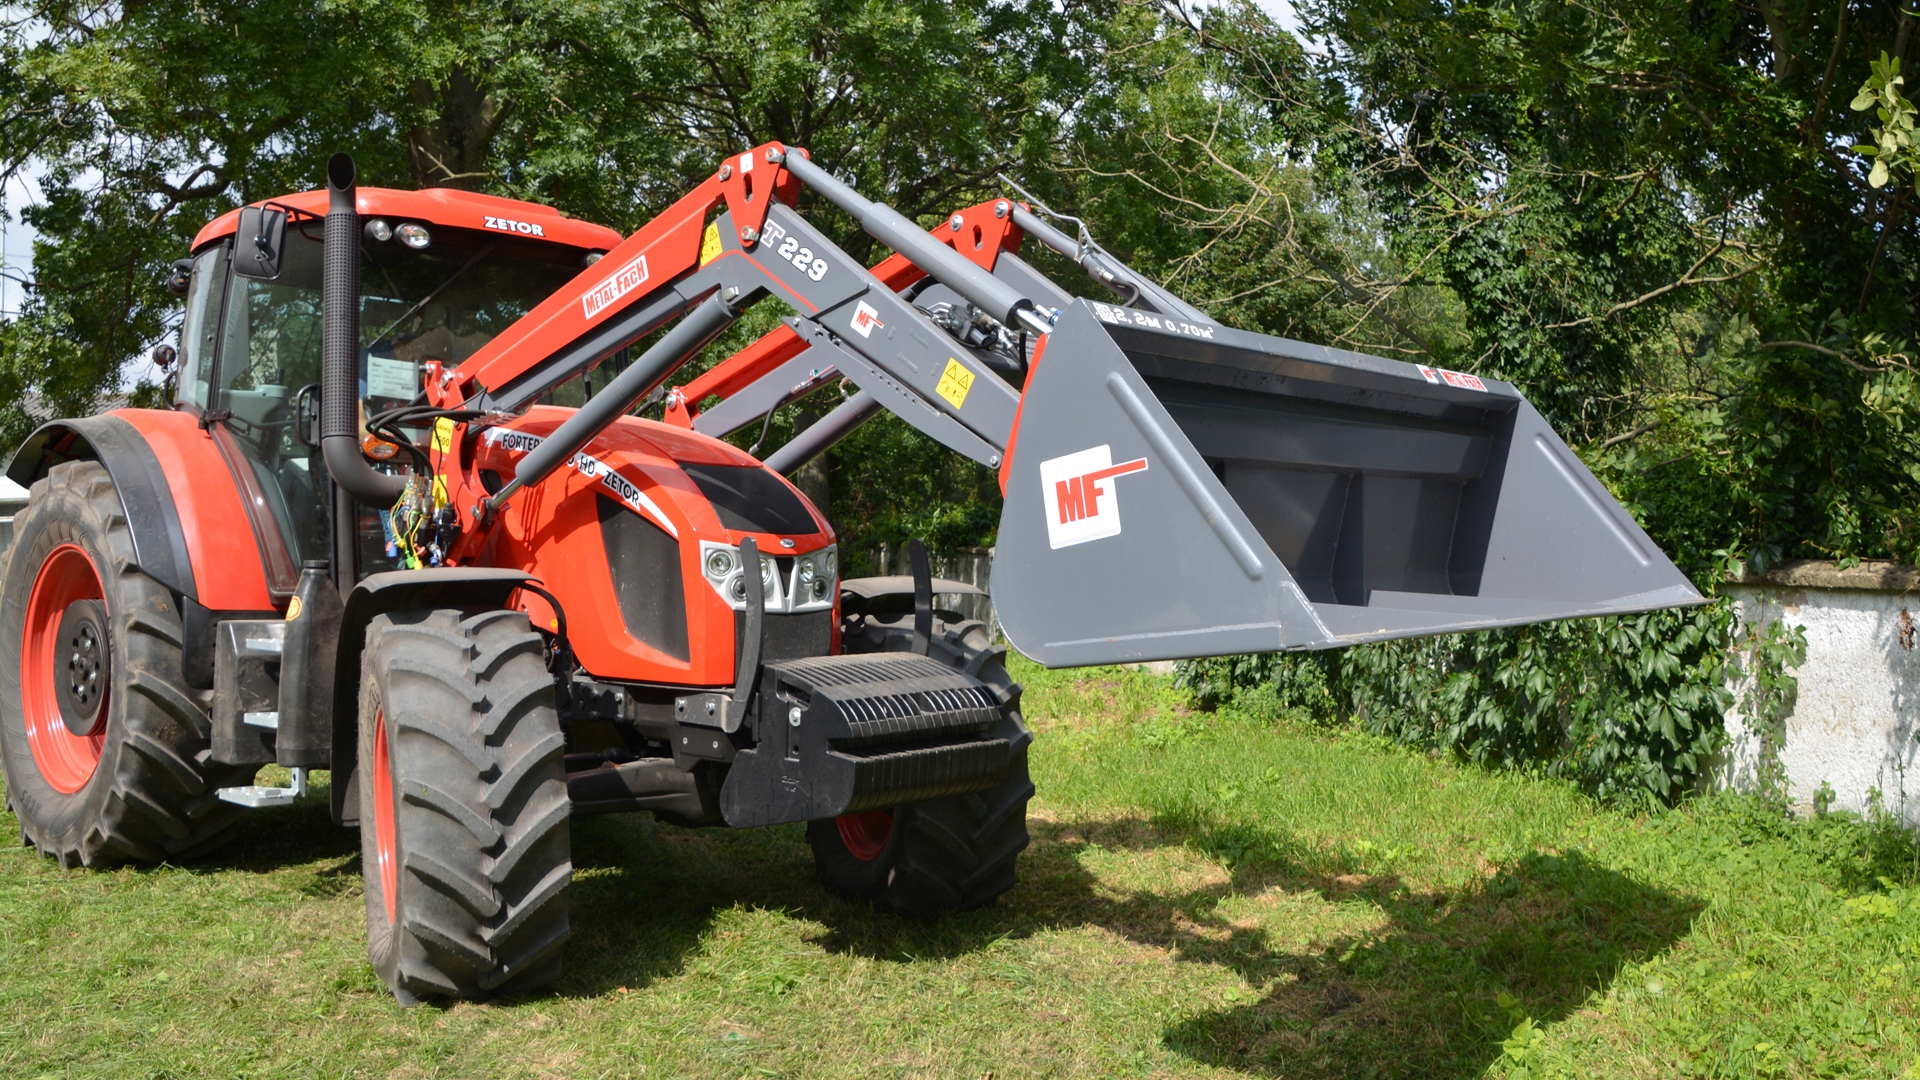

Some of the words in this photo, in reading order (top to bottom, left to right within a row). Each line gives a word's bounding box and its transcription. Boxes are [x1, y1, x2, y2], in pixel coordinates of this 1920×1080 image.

[484, 215, 546, 237] ZETOR
[585, 259, 646, 316] METAL-FACH
[856, 309, 884, 328] MF
[579, 455, 596, 475] HD
[603, 469, 640, 507] ZETOR
[1055, 459, 1147, 525] MF
